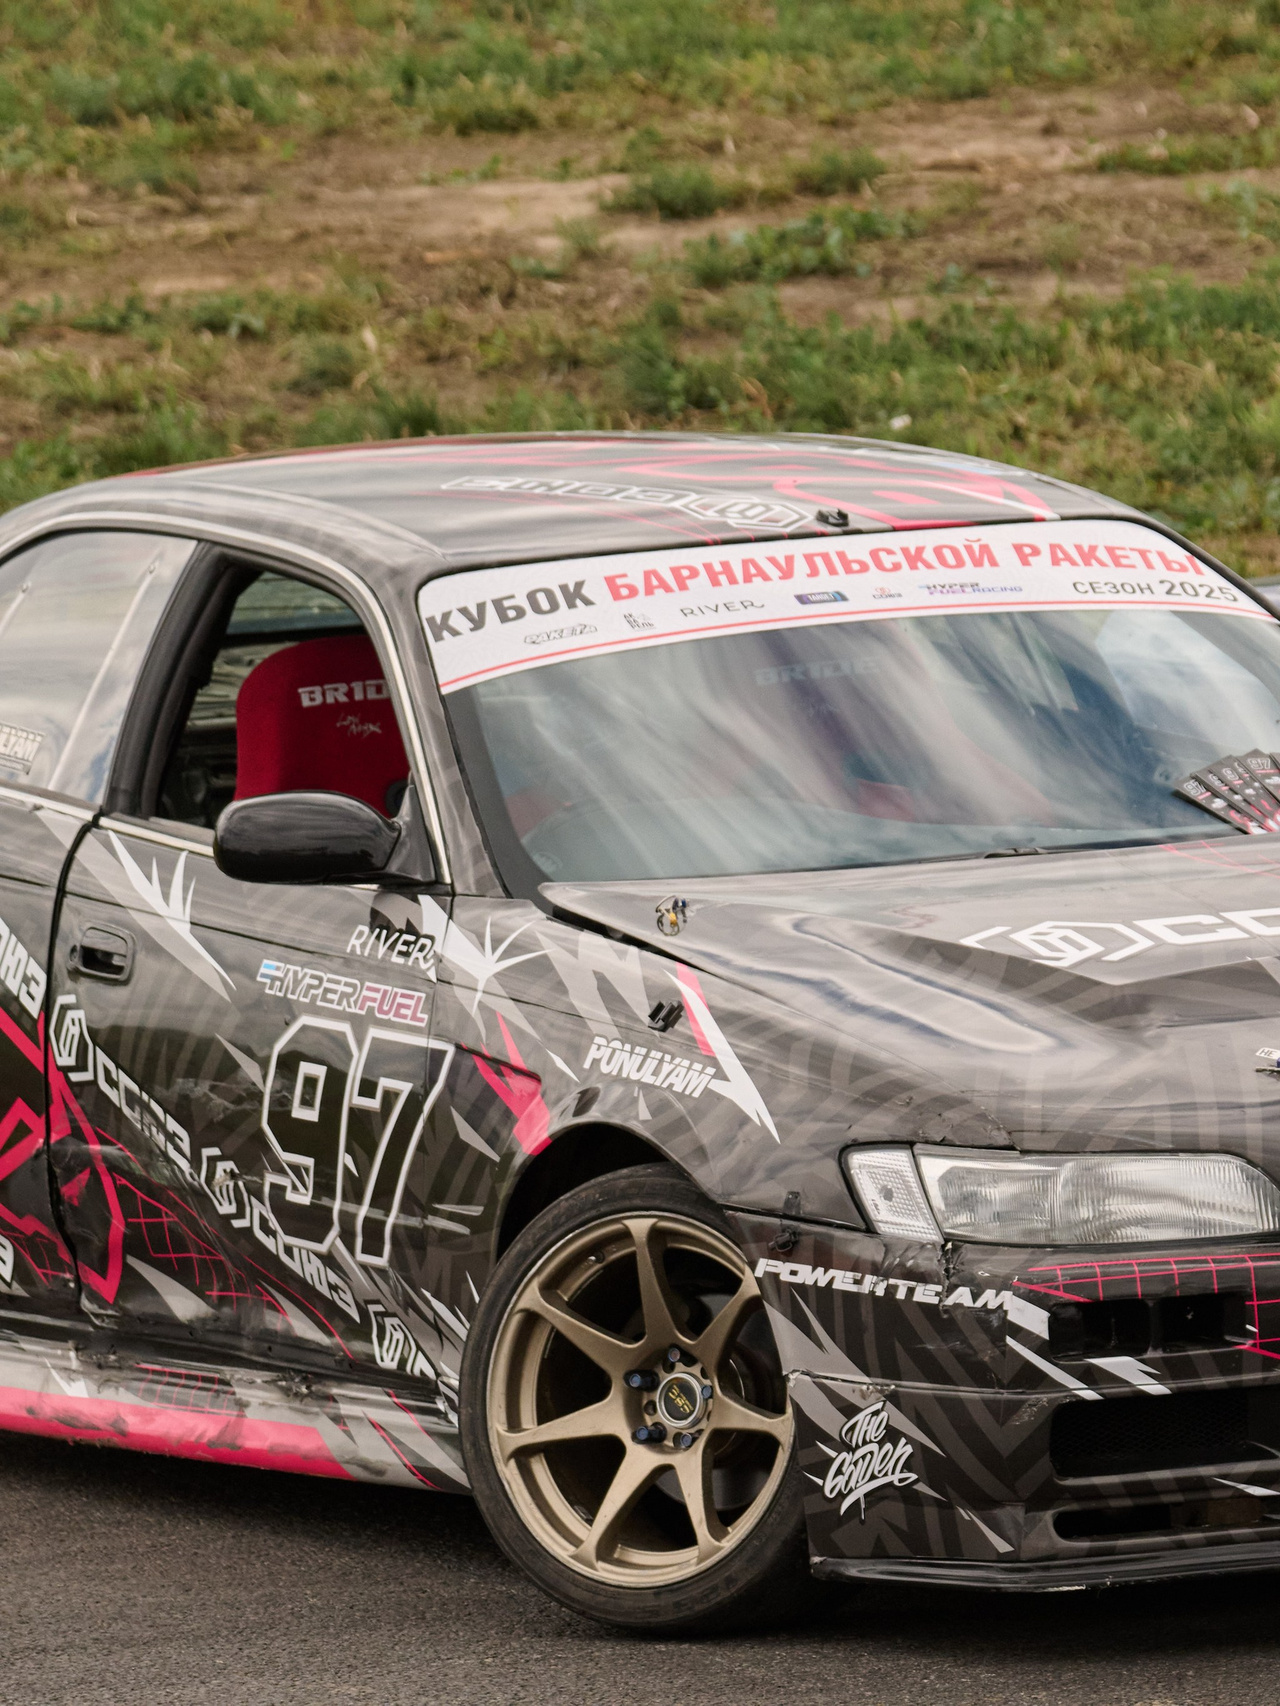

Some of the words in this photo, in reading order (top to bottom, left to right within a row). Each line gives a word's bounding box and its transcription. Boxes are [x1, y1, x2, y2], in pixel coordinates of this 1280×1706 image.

[425, 578, 597, 643] КУБОК
[603, 537, 1000, 602] БАРНАУЛЬСКОЙ
[1011, 542, 1206, 577] РАКЕТЫ
[680, 599, 765, 618] RIVER
[1073, 580, 1156, 597] СЕЗОН
[1158, 579, 1239, 603] 2025
[298, 679, 391, 708] BRID
[1222, 767, 1240, 781] 9
[0, 918, 47, 1020] ЮЗ
[346, 924, 434, 969] RIVER
[583, 1035, 716, 1098] PONULYAM
[1259, 1048, 1276, 1058] НЕ
[262, 1014, 456, 1267] 97
[754, 1257, 1013, 1311] POWERTEAM
